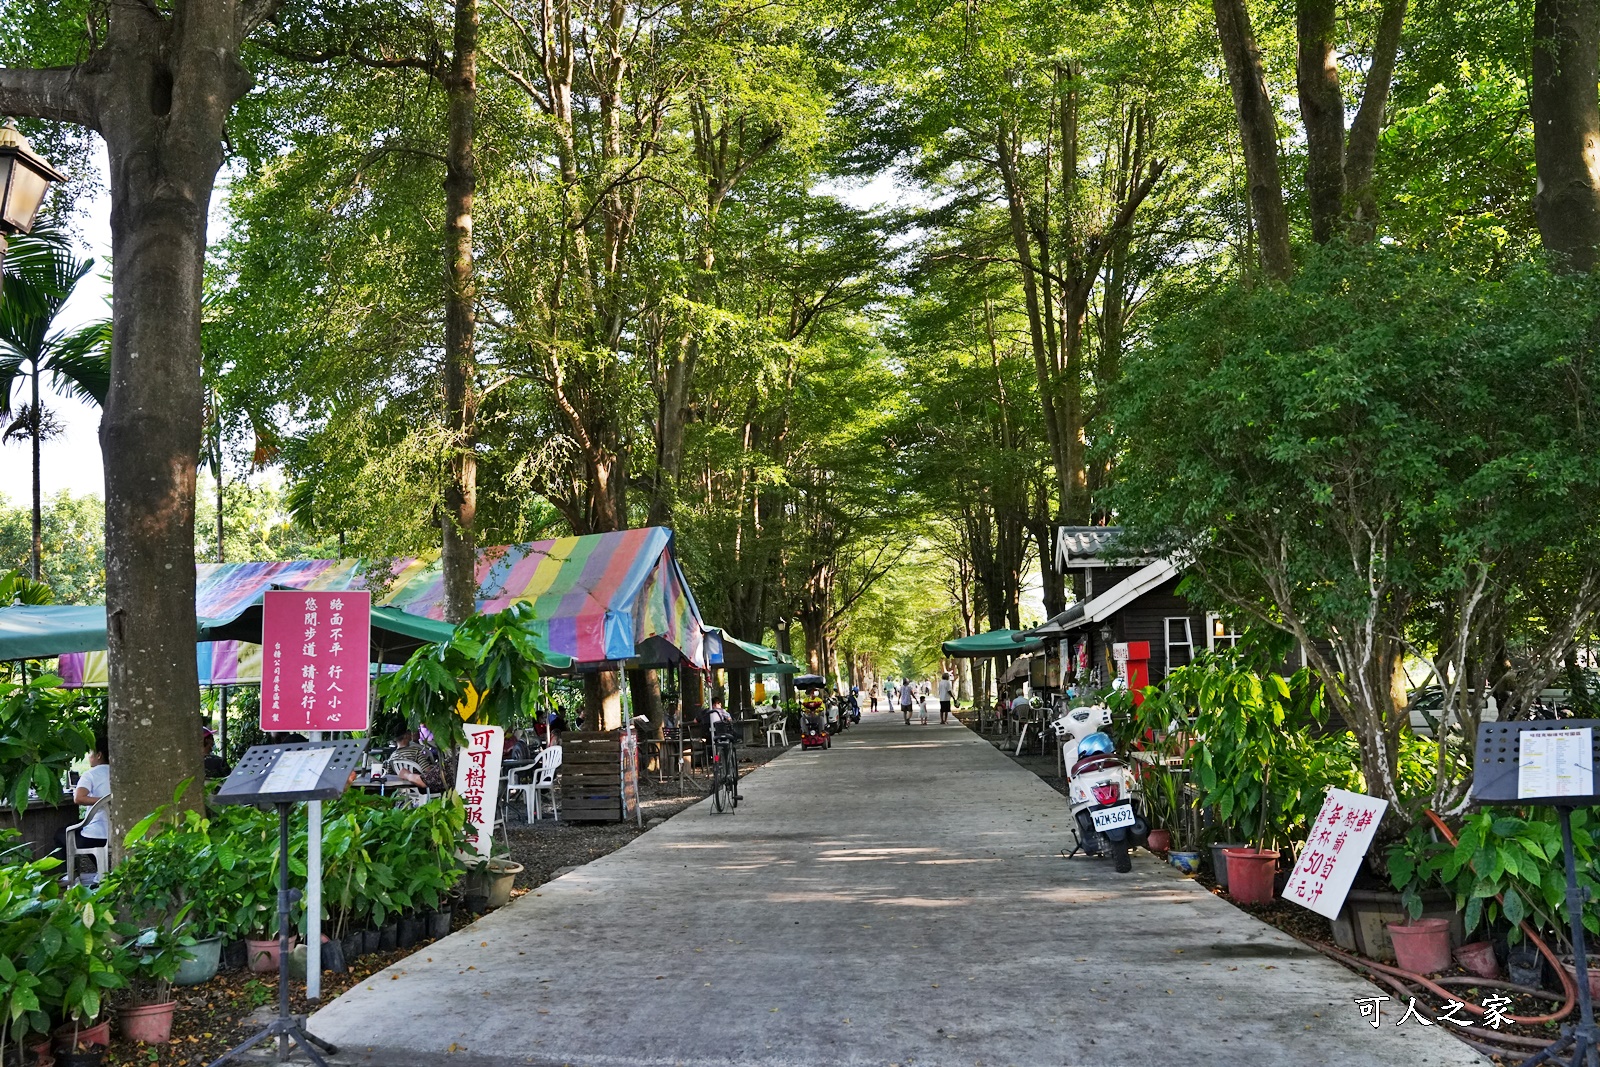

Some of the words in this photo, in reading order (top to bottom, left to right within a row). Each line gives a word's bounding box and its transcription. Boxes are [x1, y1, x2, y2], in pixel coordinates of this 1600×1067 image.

[328, 598, 345, 657] 路面不平
[327, 665, 343, 722] 行人小心
[1295, 803, 1344, 898] 每杯50元
